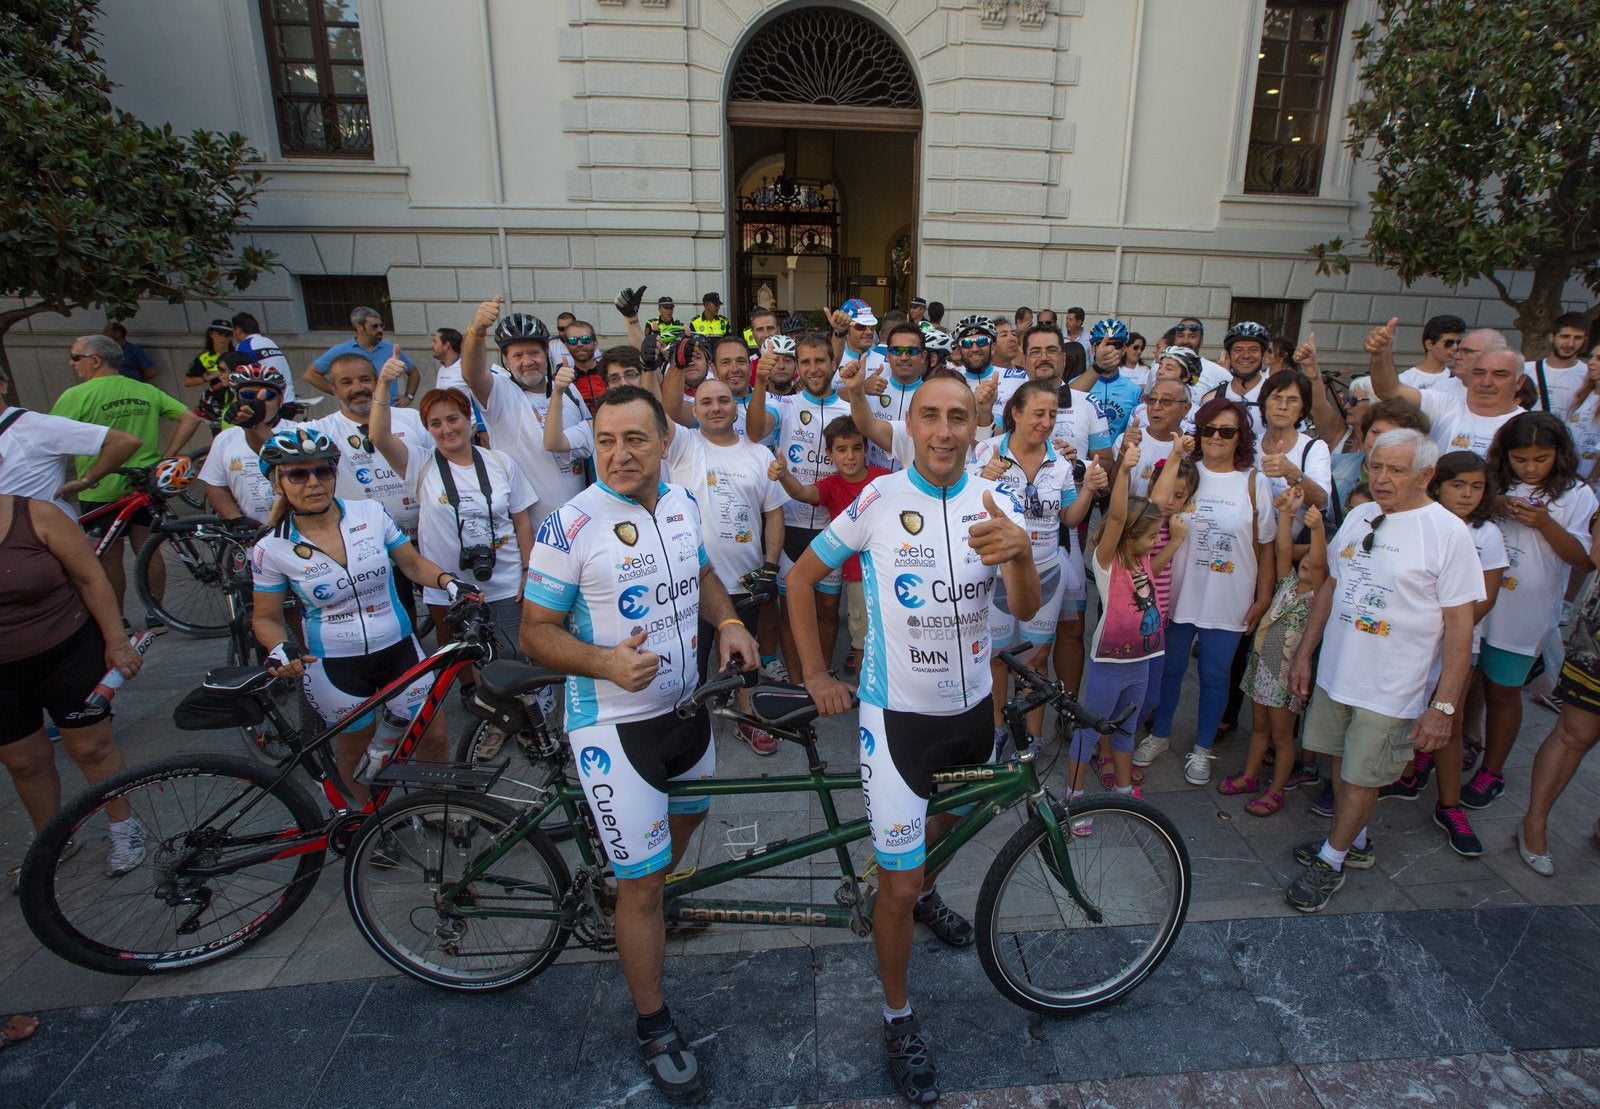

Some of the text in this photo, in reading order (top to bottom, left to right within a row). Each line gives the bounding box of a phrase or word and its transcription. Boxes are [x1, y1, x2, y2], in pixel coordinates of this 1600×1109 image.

[908, 543, 935, 559] ela
[631, 553, 655, 569] ela
[336, 565, 387, 590] Cuerva
[327, 612, 355, 622] BMN
[921, 615, 942, 628] LOS
[910, 648, 949, 665] BMN
[592, 783, 629, 861] Cuerva
[900, 817, 922, 836] ela
[678, 906, 828, 925] cannondale
[160, 945, 206, 960] ZTR
[207, 926, 250, 950] CREST
